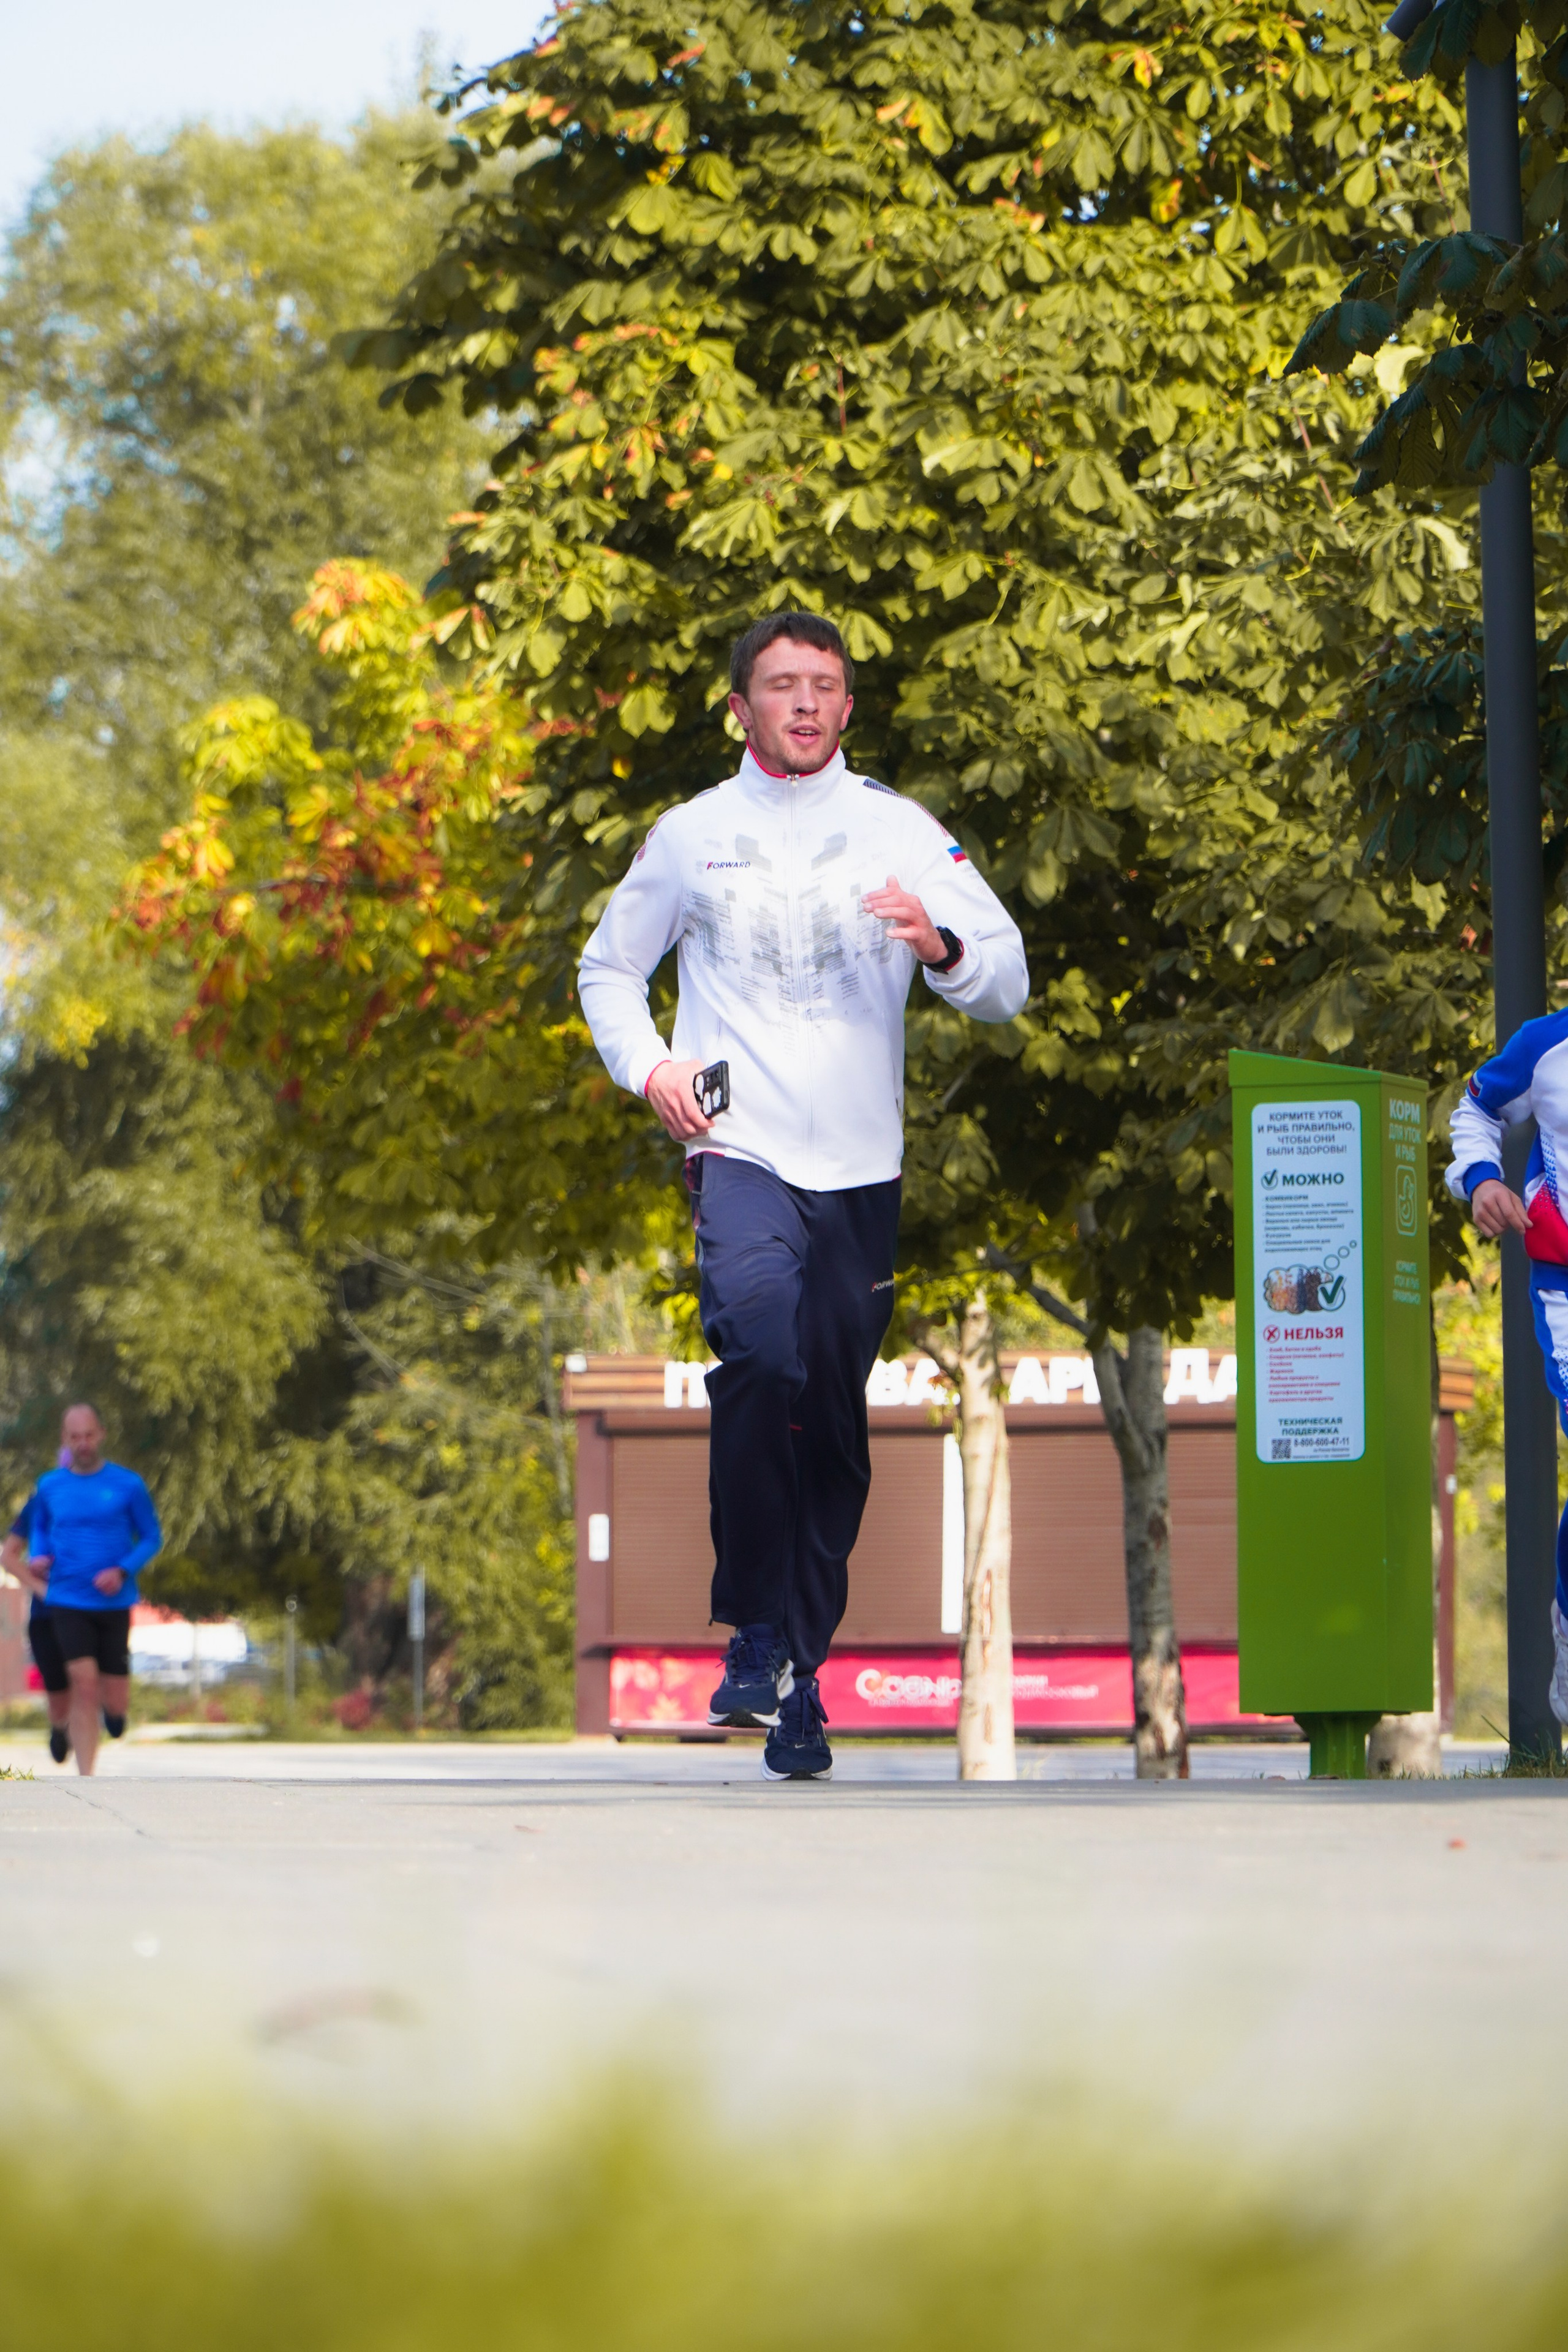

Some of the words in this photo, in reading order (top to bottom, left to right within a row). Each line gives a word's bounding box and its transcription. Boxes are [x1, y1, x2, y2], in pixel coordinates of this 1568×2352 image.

[707, 861, 751, 870] FORWARD
[1269, 1111, 1316, 1121] КОРМИТЕ
[1318, 1110, 1343, 1120] УТОК
[1389, 1098, 1420, 1125] КОРМ
[1257, 1125, 1265, 1133] И
[1267, 1123, 1289, 1133] РЫБ
[1292, 1121, 1355, 1133] ПРАВИЛЬНО,
[1278, 1135, 1311, 1145] ЧТОБЫ
[1313, 1134, 1335, 1144] ОНИ
[1267, 1146, 1294, 1156] БЫЛИ
[1296, 1145, 1348, 1156] ЗДОРОВЫ!
[1282, 1172, 1345, 1186] МОЖНО
[1284, 1326, 1344, 1340] НЕЛЬЗЯ
[1278, 1417, 1343, 1426] ТЕХНИЧЕСКАЯ
[1282, 1427, 1340, 1436] ПОДДЕРЖКА
